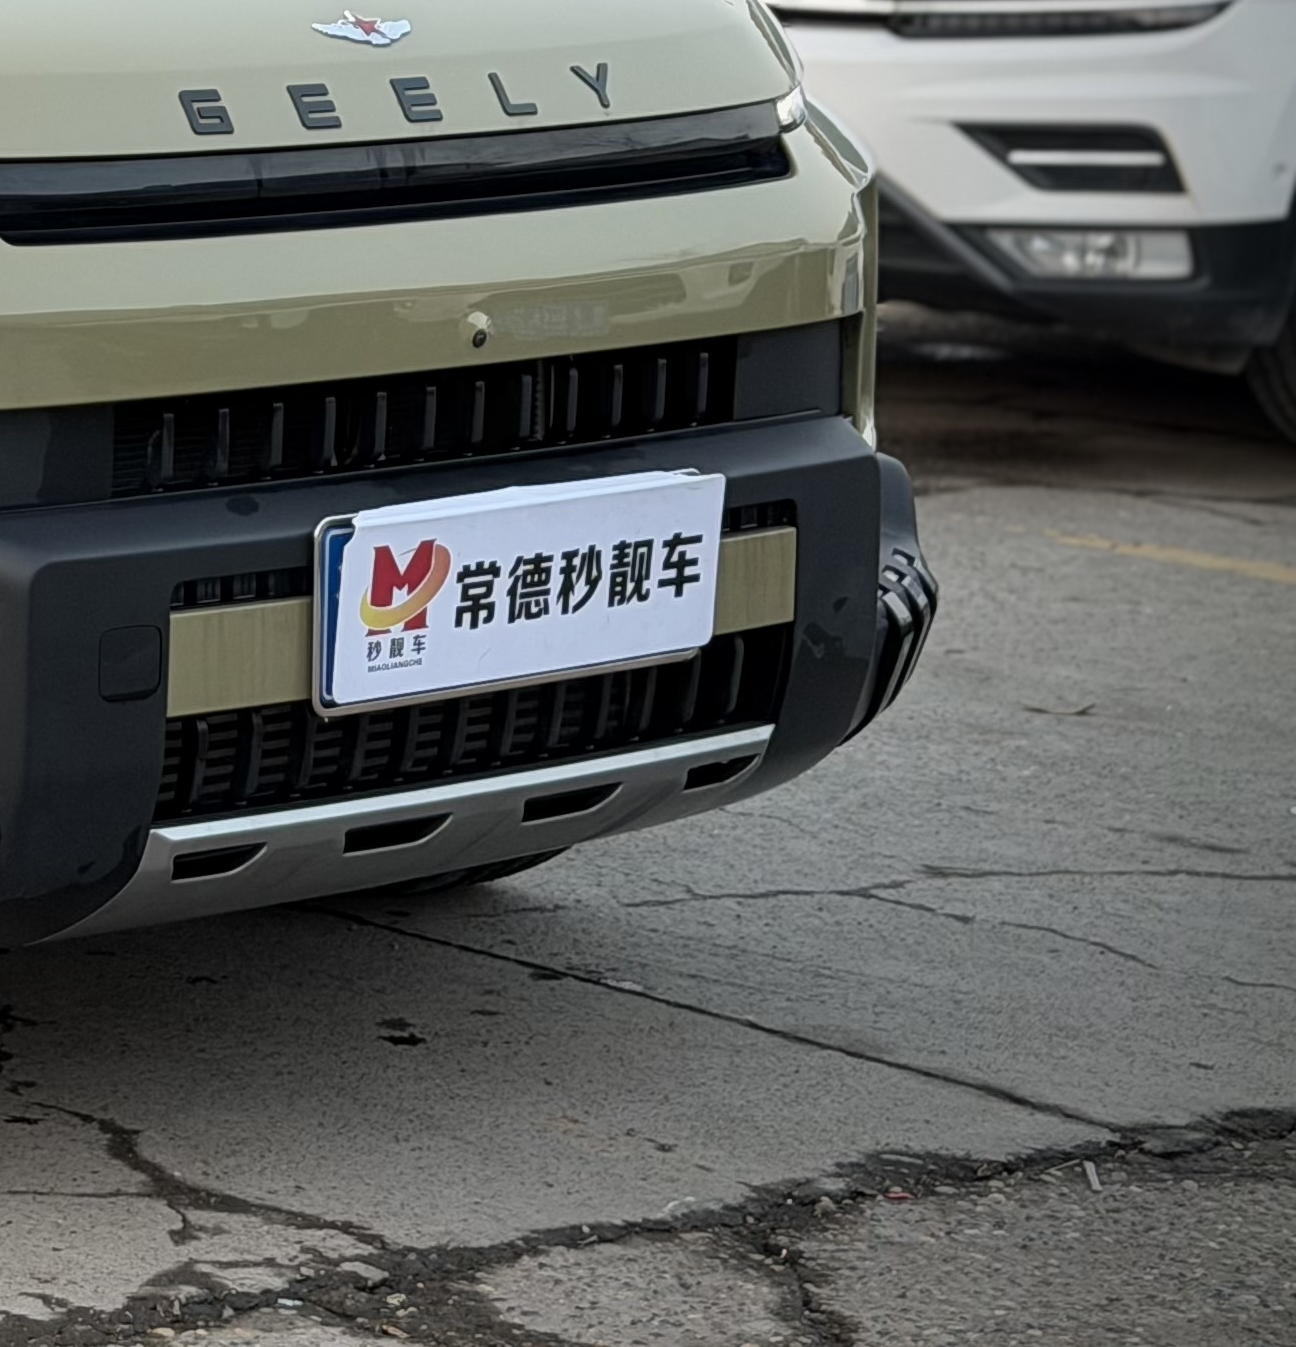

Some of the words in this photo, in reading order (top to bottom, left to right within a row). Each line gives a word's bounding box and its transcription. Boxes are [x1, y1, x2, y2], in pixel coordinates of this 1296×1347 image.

[177, 62, 611, 136] GEELY
[454, 531, 704, 631] 常德秒靓车
[366, 634, 427, 663] 秒靓车
[367, 657, 423, 673] MIAOLIANGCHE
